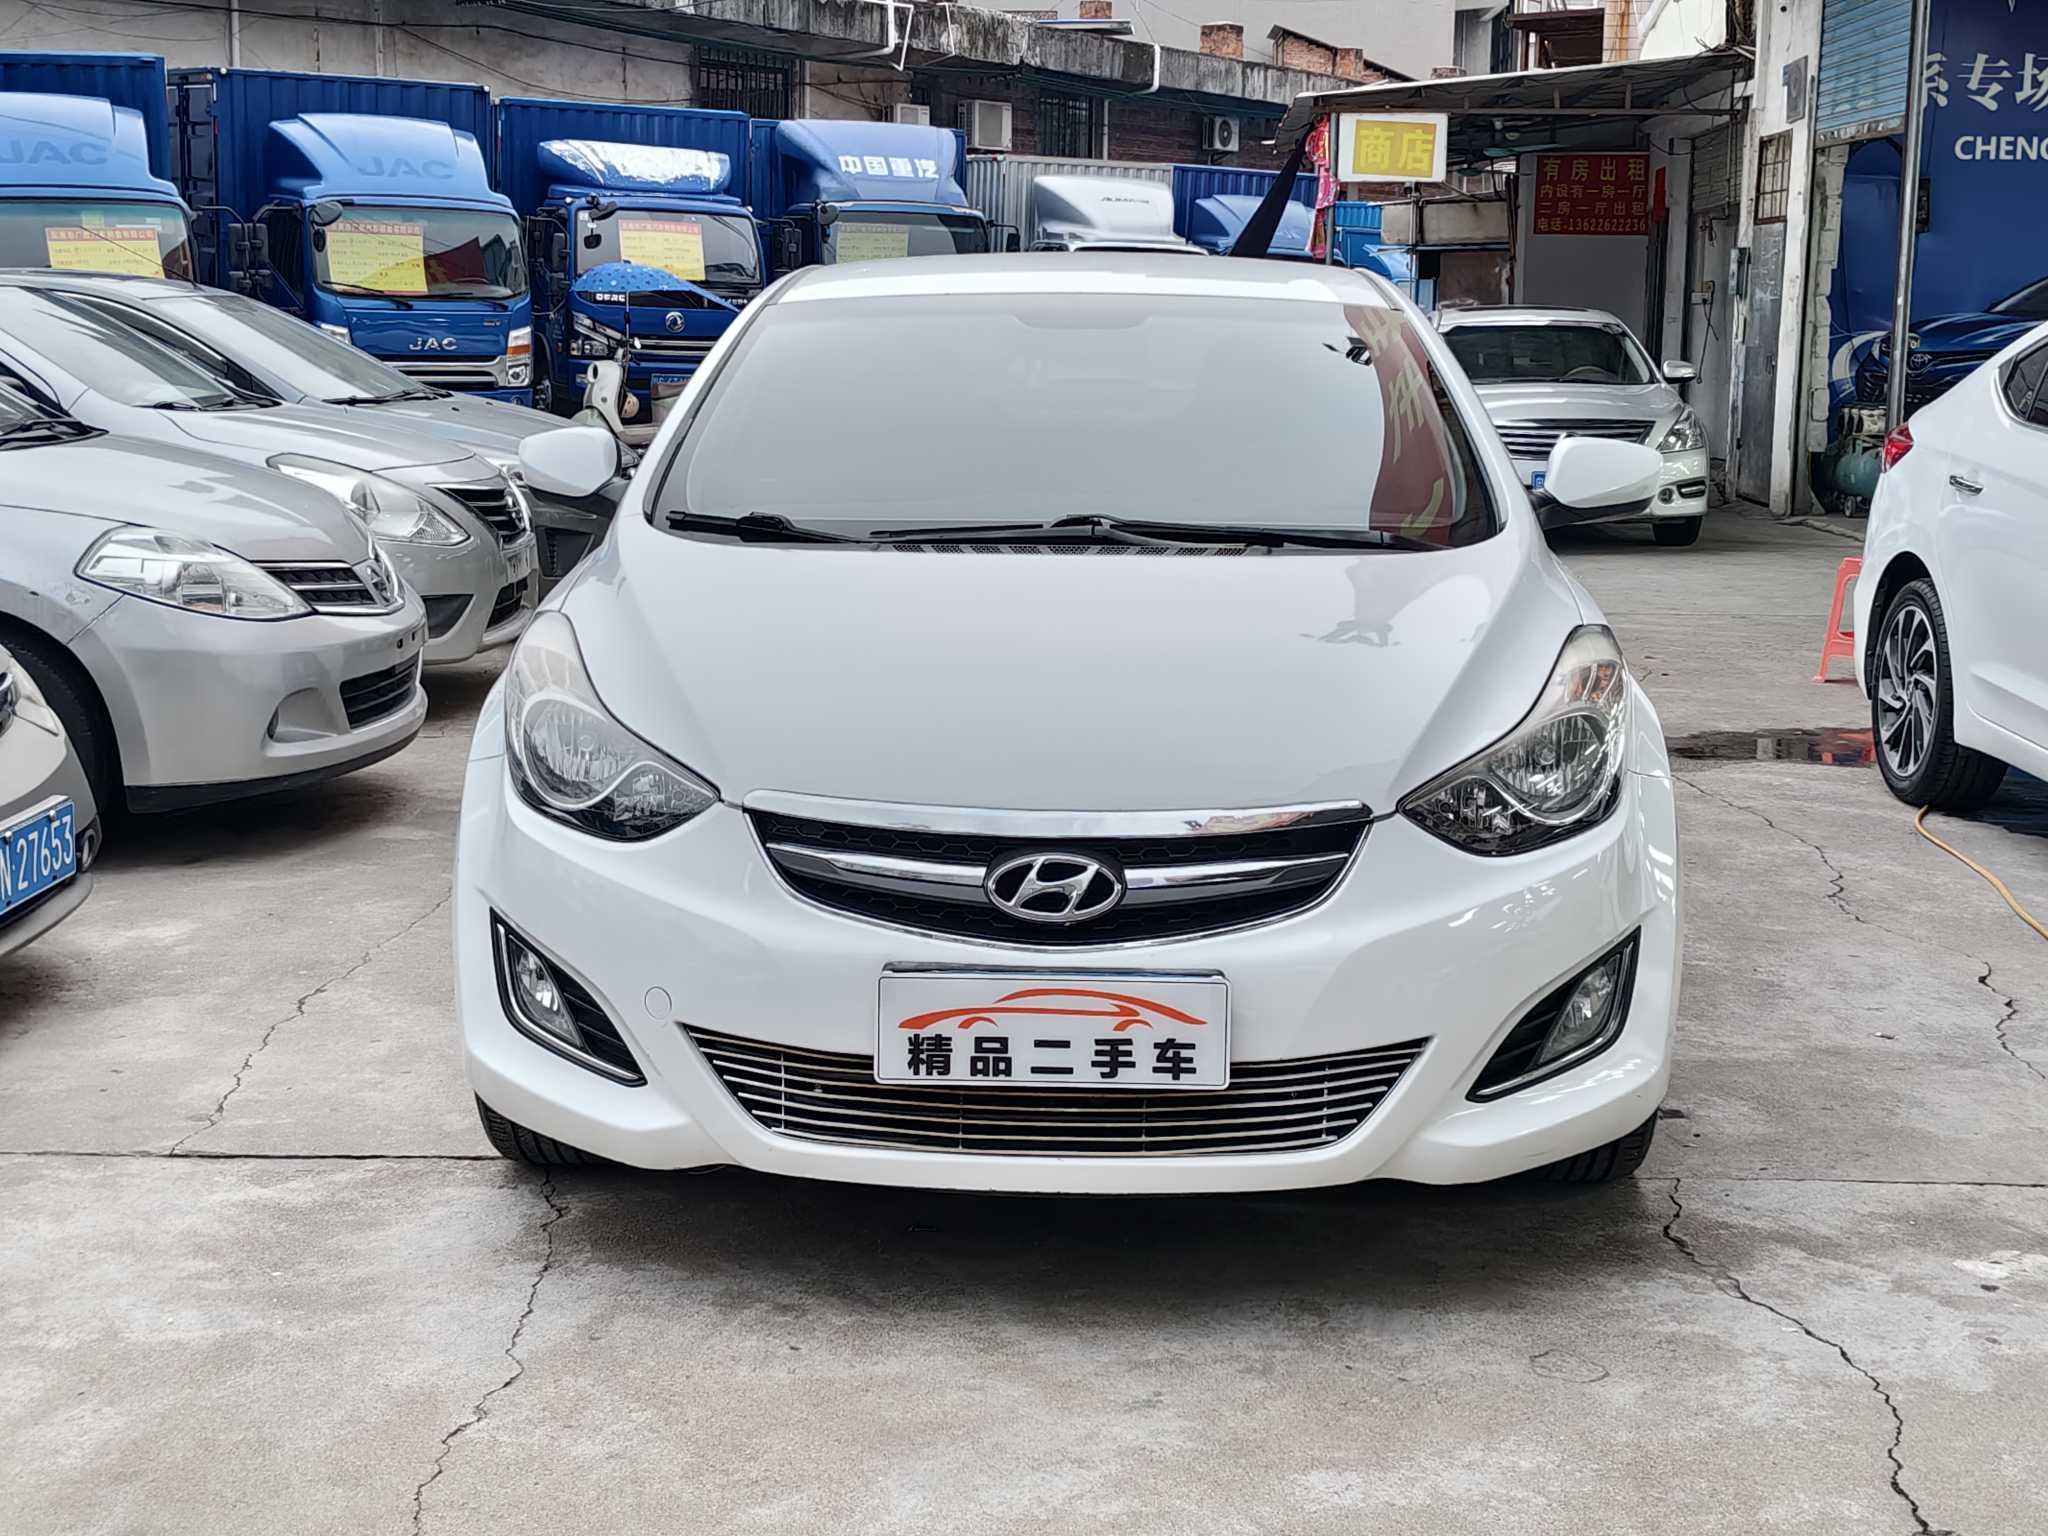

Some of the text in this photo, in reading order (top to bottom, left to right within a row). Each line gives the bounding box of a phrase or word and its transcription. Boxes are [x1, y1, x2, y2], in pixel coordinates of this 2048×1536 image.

[0, 139, 108, 165] JAC
[1358, 127, 1435, 170] 商店
[1955, 135, 2048, 161] CHEN
[358, 155, 455, 180] JAC
[1543, 157, 1646, 181] 有房出租
[1540, 183, 1646, 199] 内设有一房一厅
[409, 337, 457, 351] JAC
[907, 1033, 1198, 1080] 精品二手车
